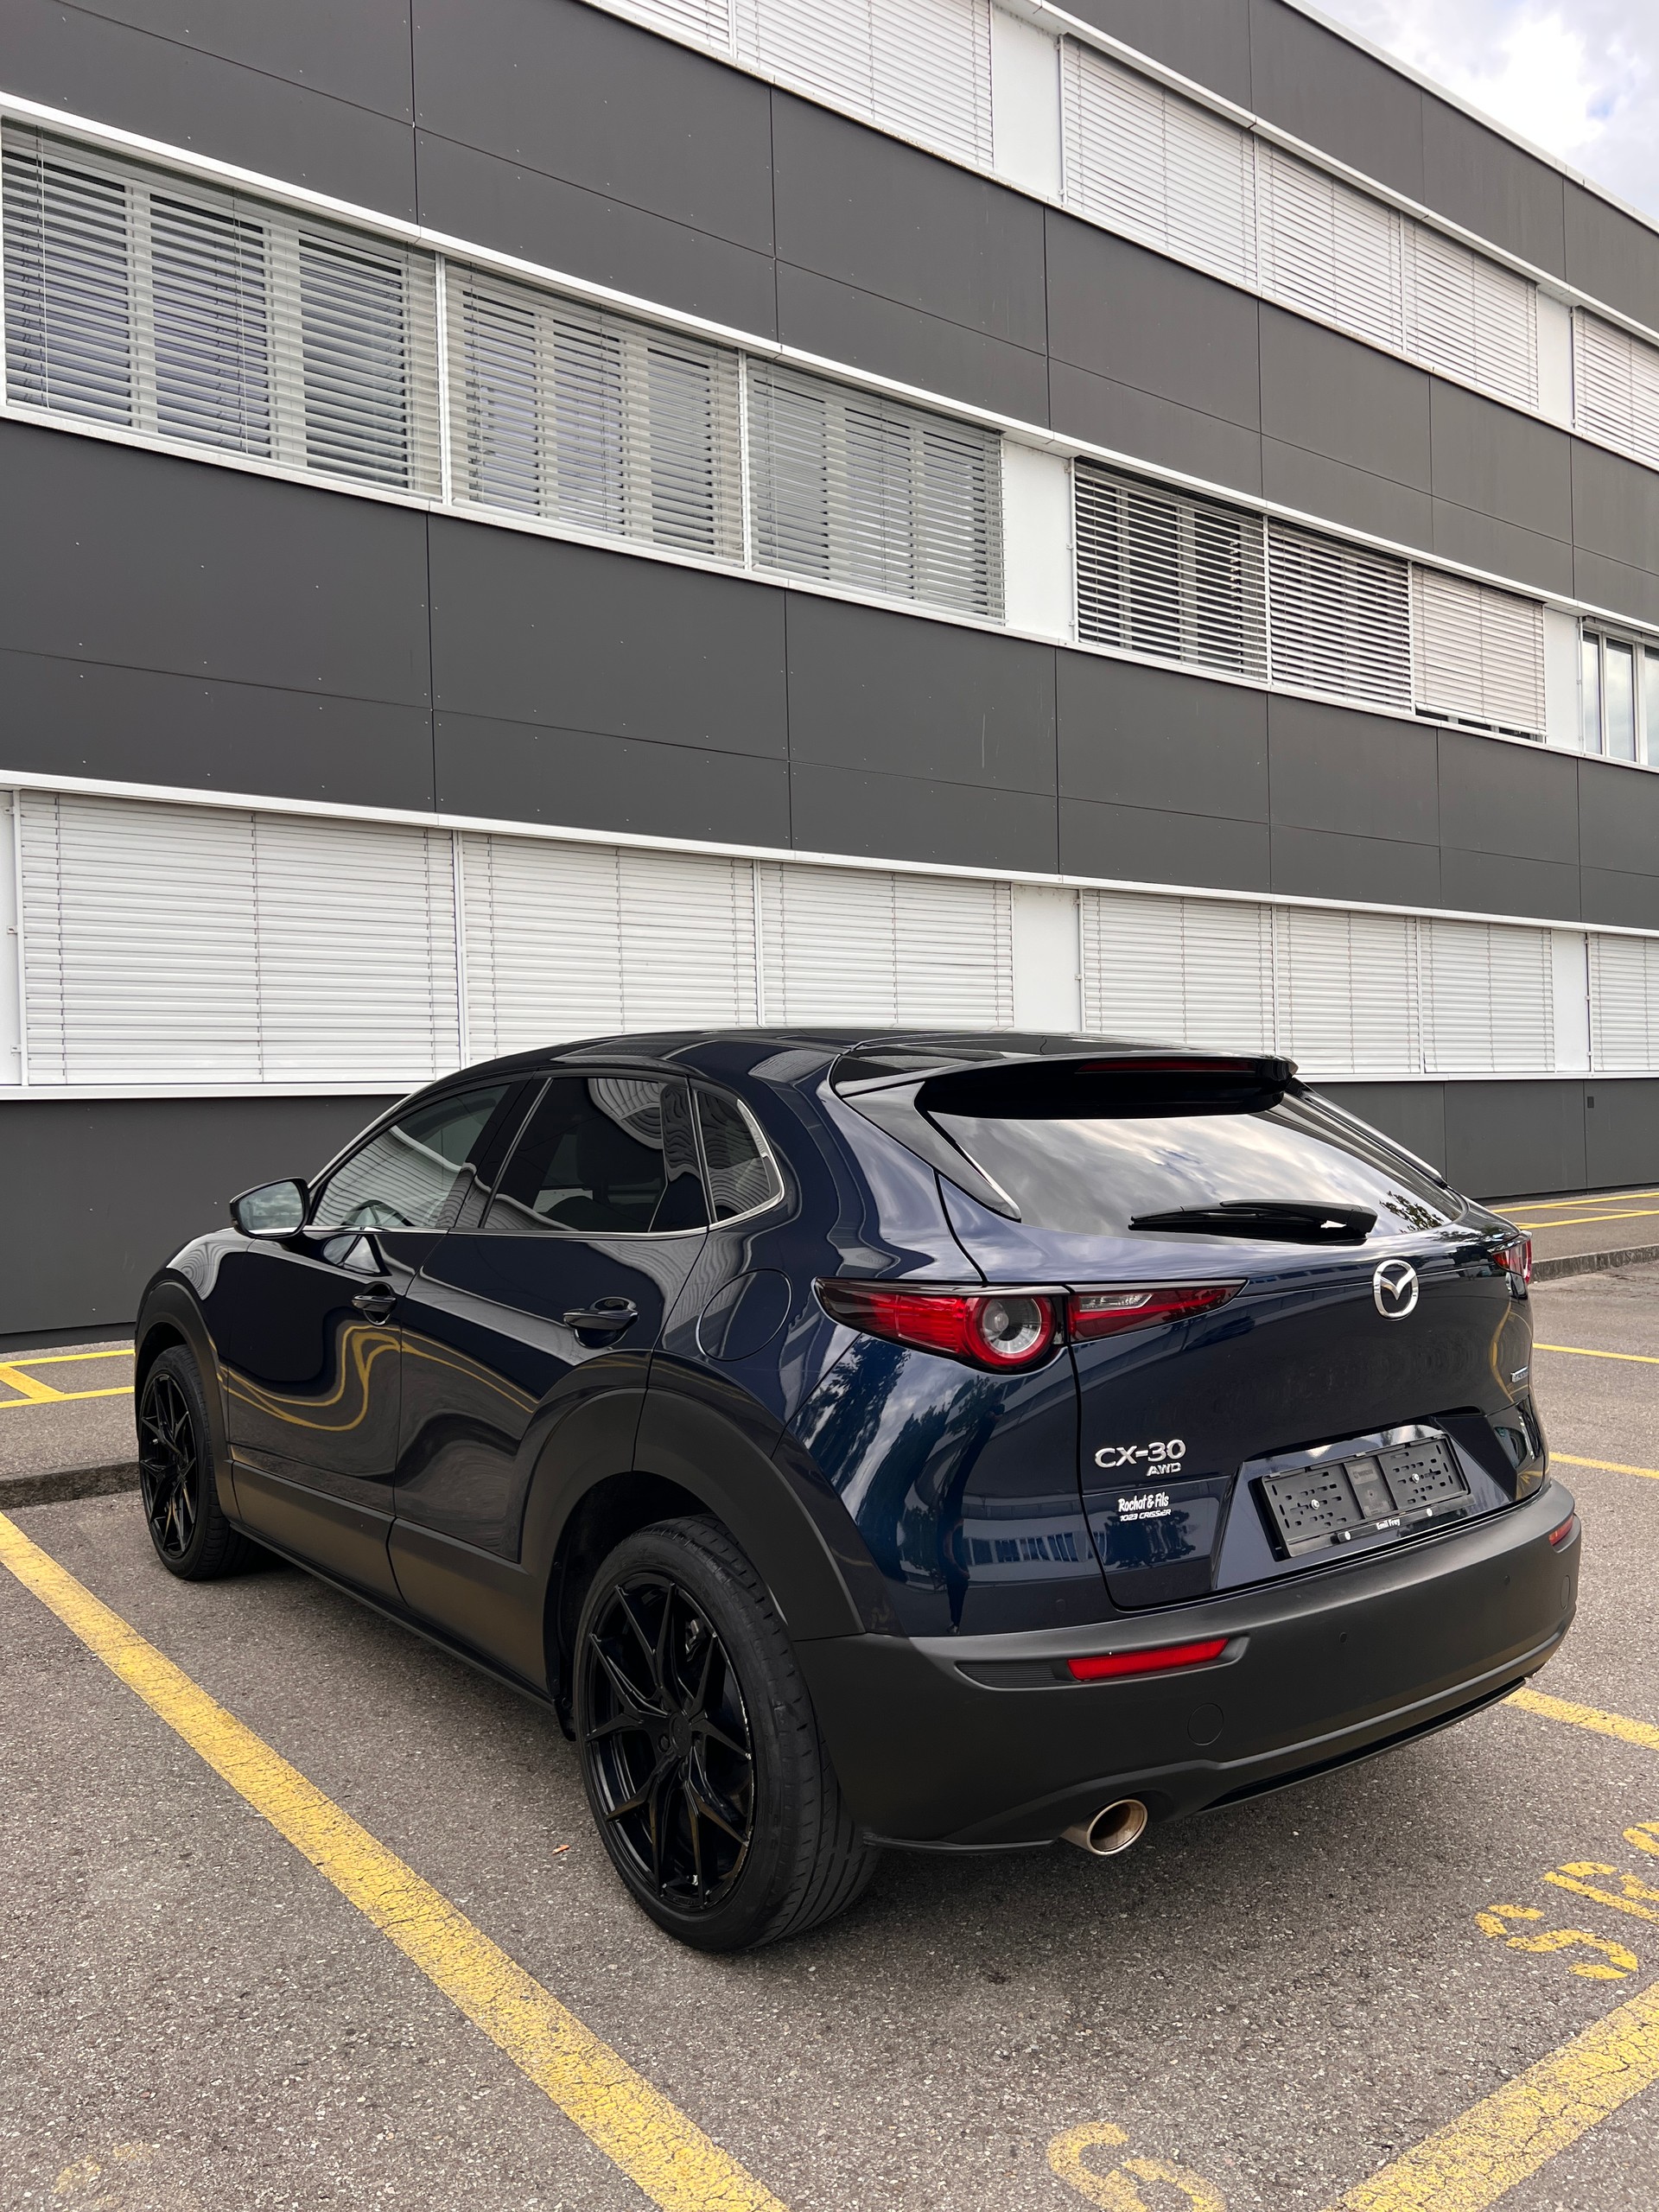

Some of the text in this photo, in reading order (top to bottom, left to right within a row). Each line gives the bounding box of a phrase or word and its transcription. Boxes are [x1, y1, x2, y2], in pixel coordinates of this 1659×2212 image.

[1095, 1439, 1186, 1468] CX-30
[1147, 1462, 1182, 1477] AWD
[1118, 1491, 1170, 1512] Rochat & Fils
[1120, 1513, 1138, 1522] 1023
[1376, 1518, 1400, 1530] Emil Frey
